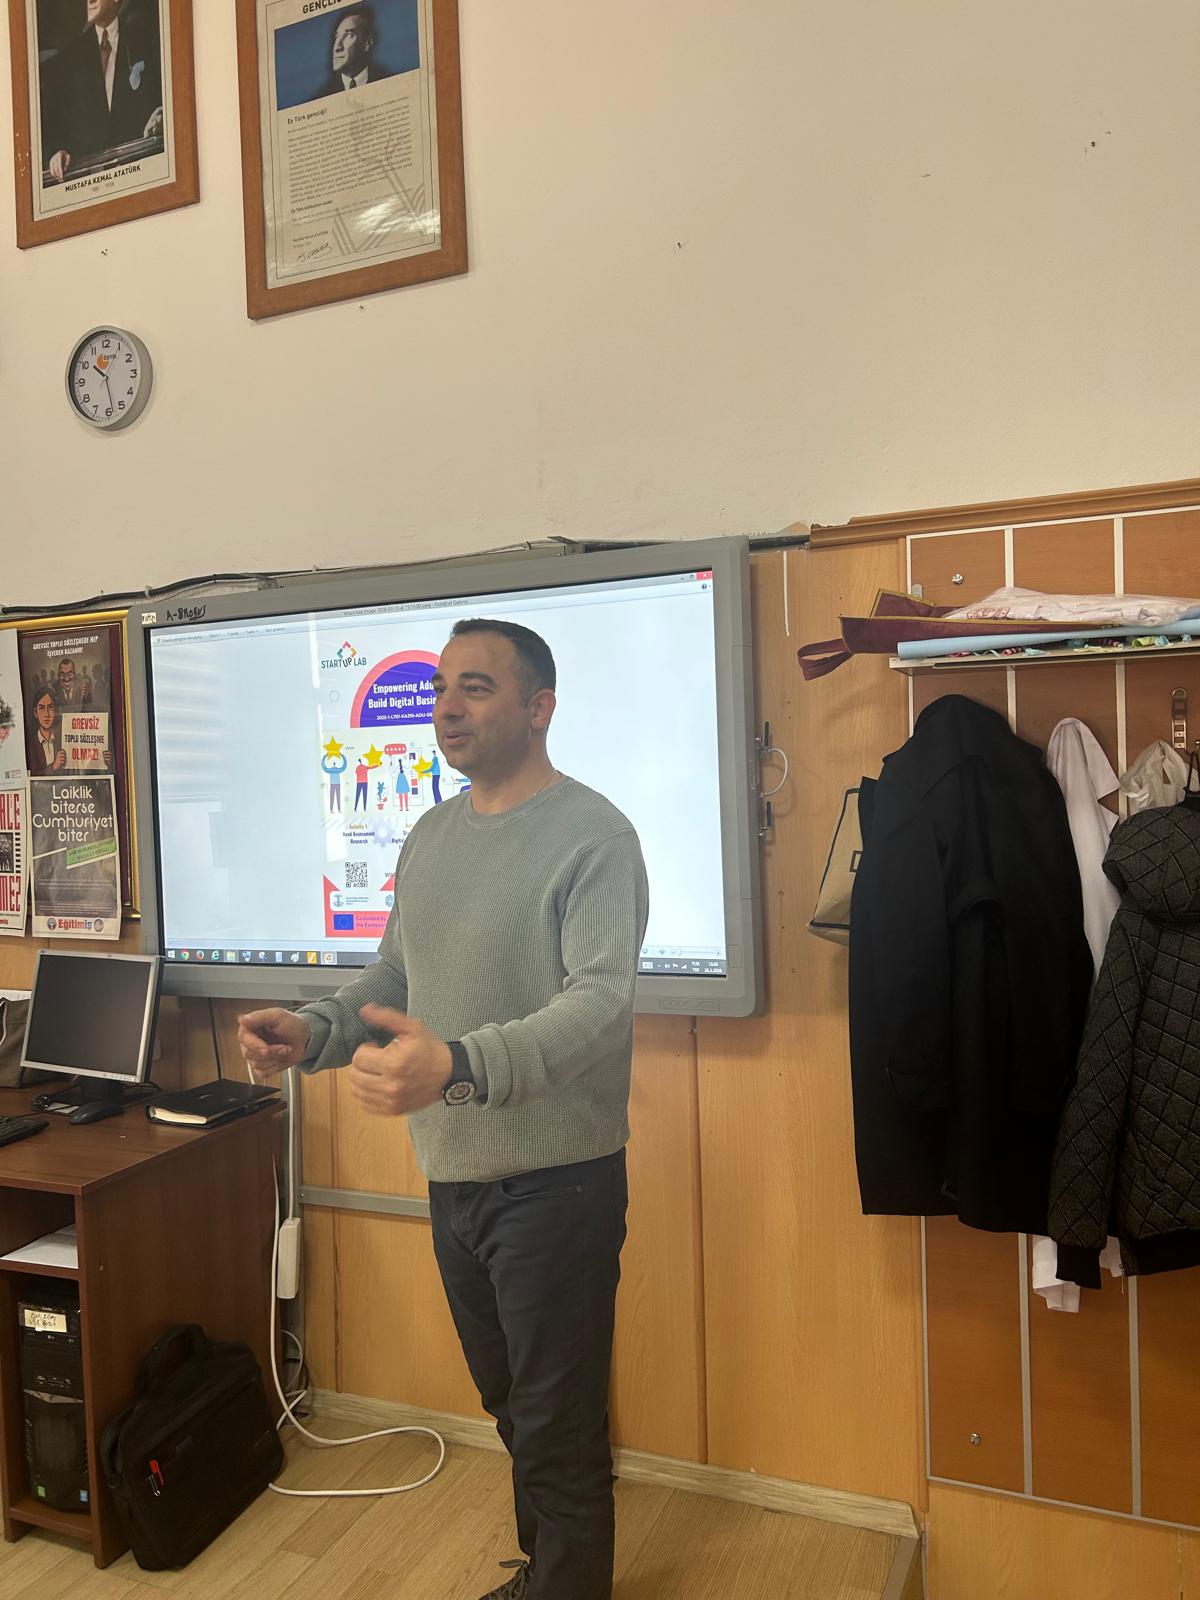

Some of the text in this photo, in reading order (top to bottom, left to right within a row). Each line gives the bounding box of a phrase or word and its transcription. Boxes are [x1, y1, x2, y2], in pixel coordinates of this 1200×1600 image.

[294, 114, 306, 123] Türk
[65, 164, 141, 193] MUSTAFA KEMAL ATATÜRK
[102, 339, 111, 348] 12
[91, 346, 97, 356] 11
[125, 354, 133, 363] 2
[82, 361, 90, 370] 10
[130, 369, 138, 379] 3
[79, 378, 86, 387] 9
[127, 387, 134, 395] 4
[83, 394, 91, 403] 8
[93, 405, 99, 415] 7
[118, 401, 126, 410] 5
[106, 408, 113, 417] 6
[353, 657, 367, 666] LAB
[373, 680, 434, 695] Empowering Adu
[368, 695, 437, 709] Build Digital Busin
[72, 716, 99, 730] GREVSİZ
[65, 733, 105, 746] TOPLU SÖZLEŞME
[72, 748, 99, 760] OLMAZ!
[52, 785, 93, 799] Laiklik
[51, 800, 95, 814] biterse
[32, 813, 113, 831] Cumhuriyet
[58, 829, 89, 842] biter
